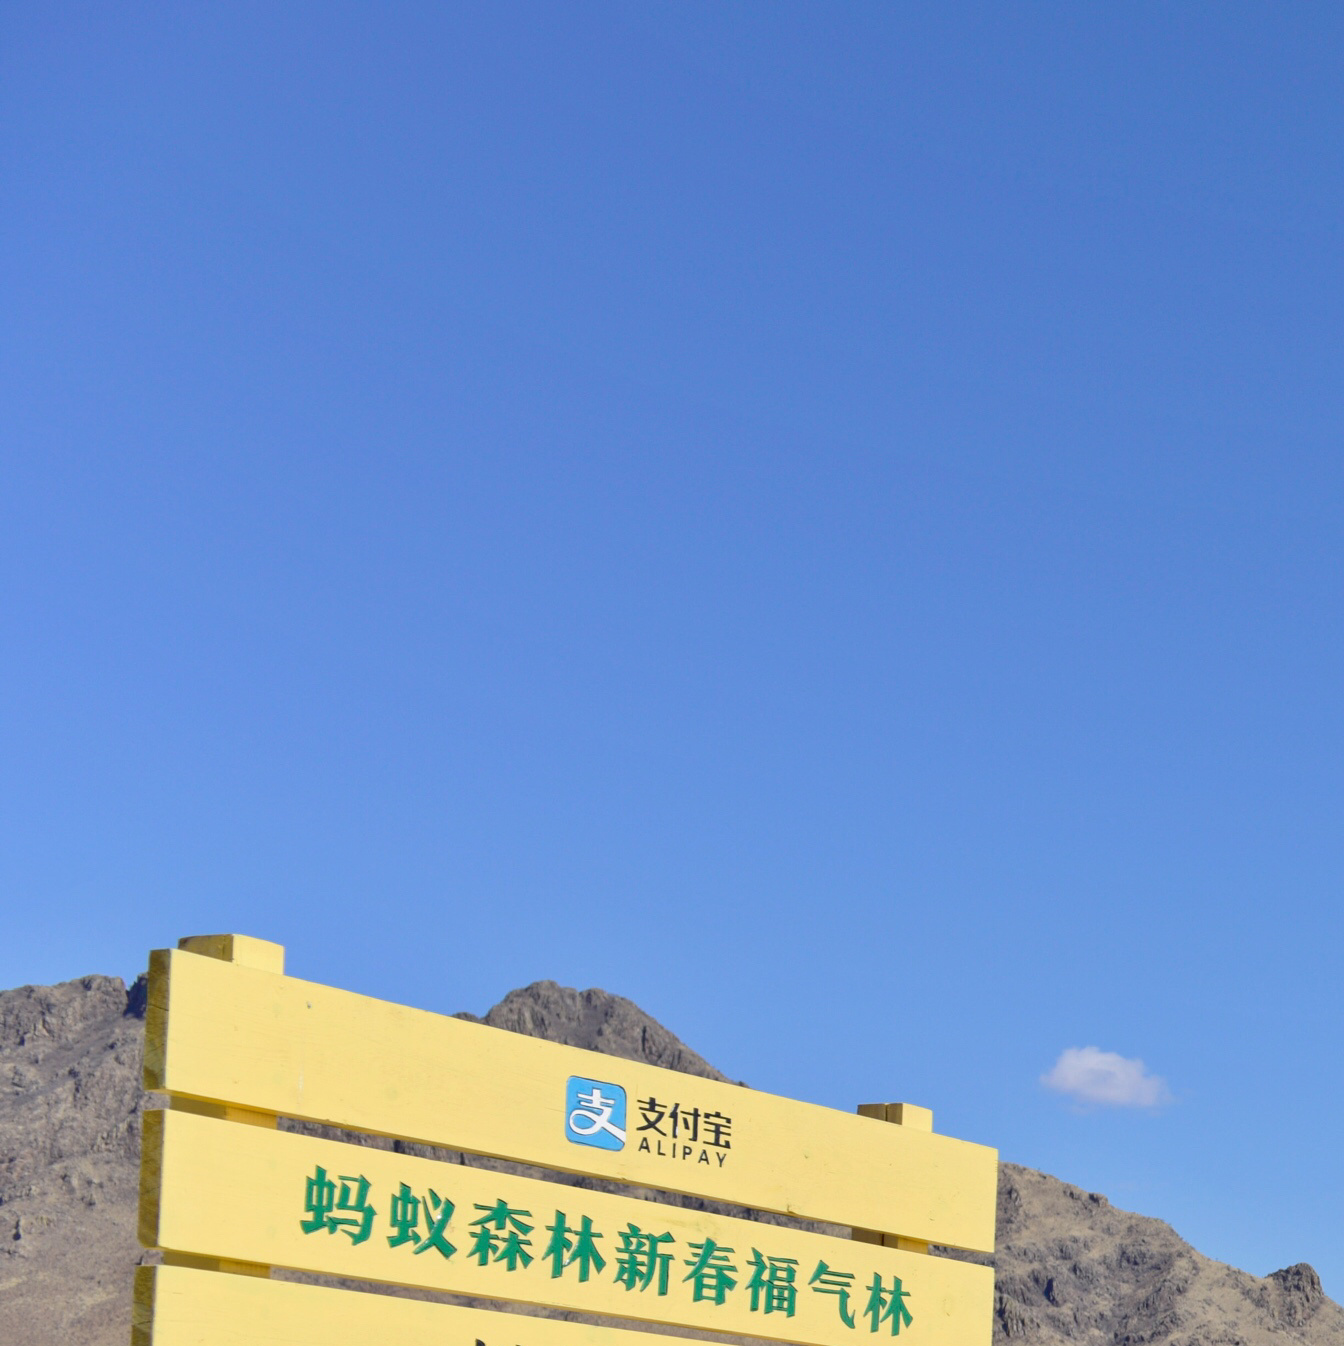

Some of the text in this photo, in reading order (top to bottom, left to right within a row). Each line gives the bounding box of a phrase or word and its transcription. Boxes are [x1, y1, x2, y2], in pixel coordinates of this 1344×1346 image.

[637, 1097, 731, 1150] 支付宝
[638, 1136, 727, 1168] ALIPAY
[300, 1164, 914, 1337] 蚂蚁森林新春福气林
